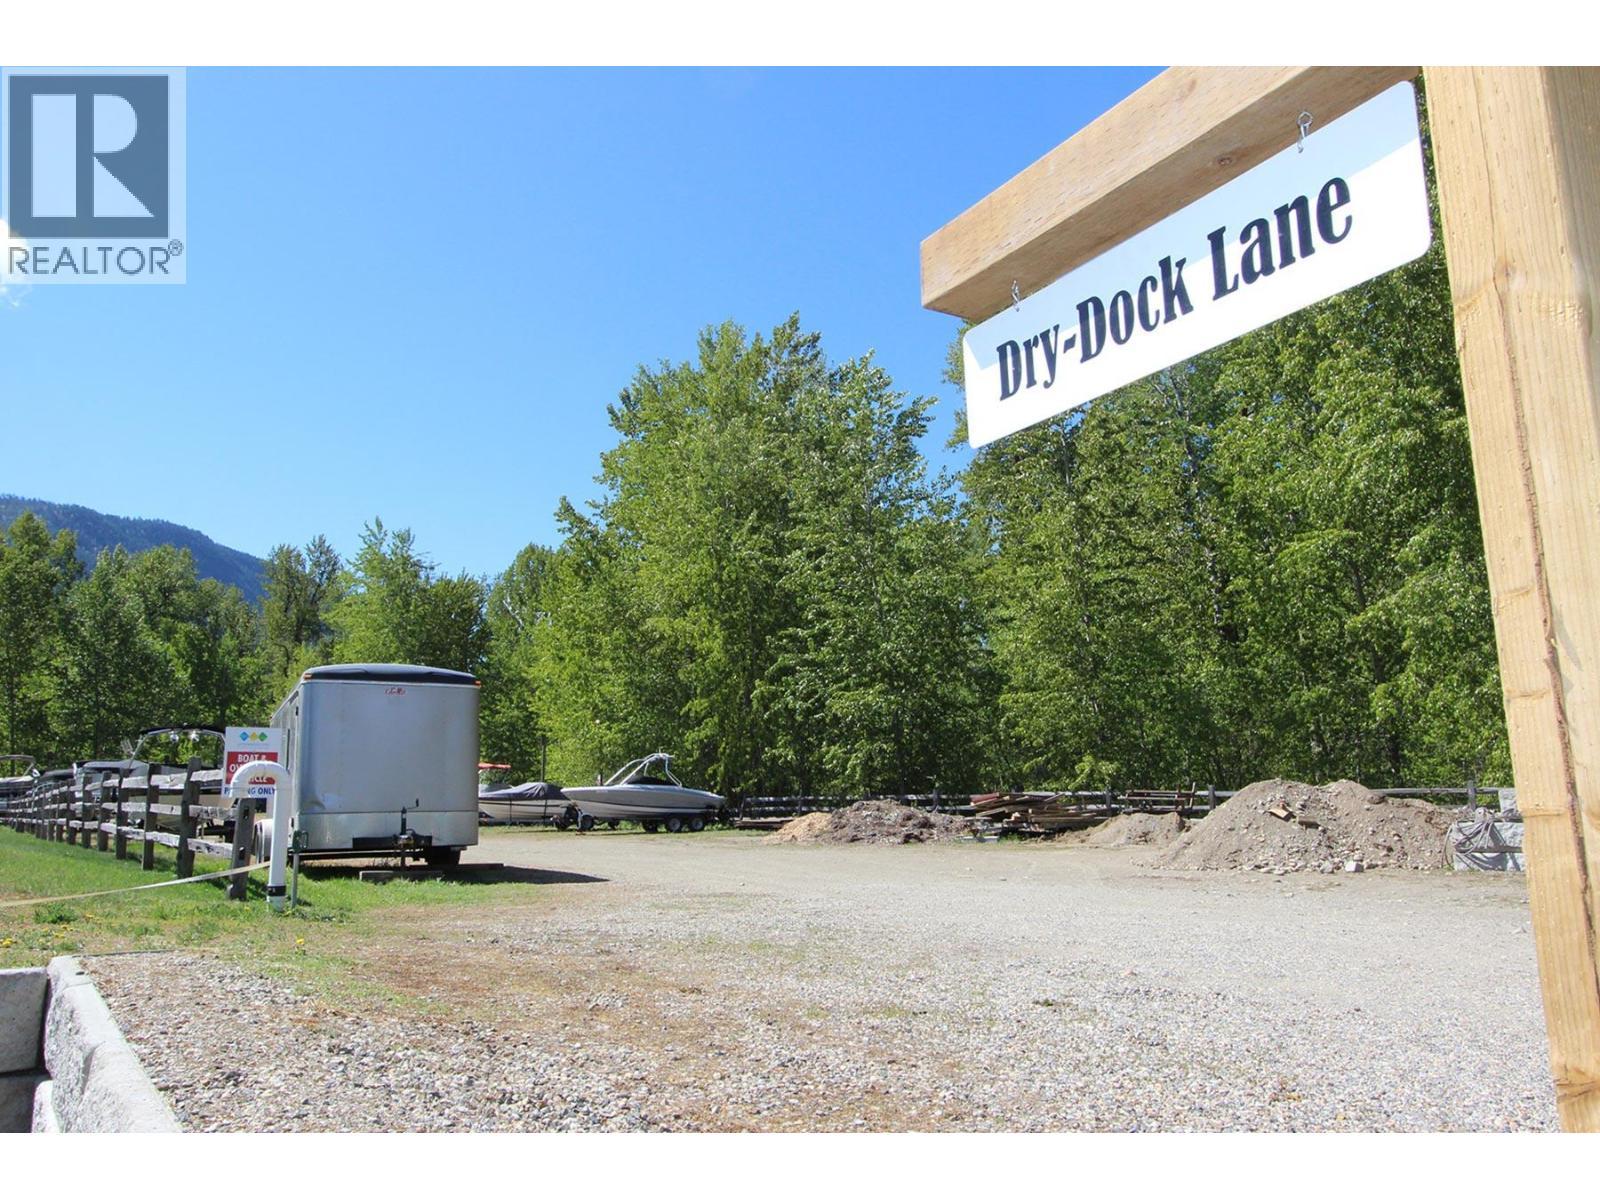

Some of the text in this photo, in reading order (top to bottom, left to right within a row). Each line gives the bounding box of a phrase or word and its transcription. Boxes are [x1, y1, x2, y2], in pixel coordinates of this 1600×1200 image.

[996, 177, 1353, 401] Dry-Dock Lane
[238, 754, 259, 762] BOAT
[257, 787, 275, 795] ONLY
